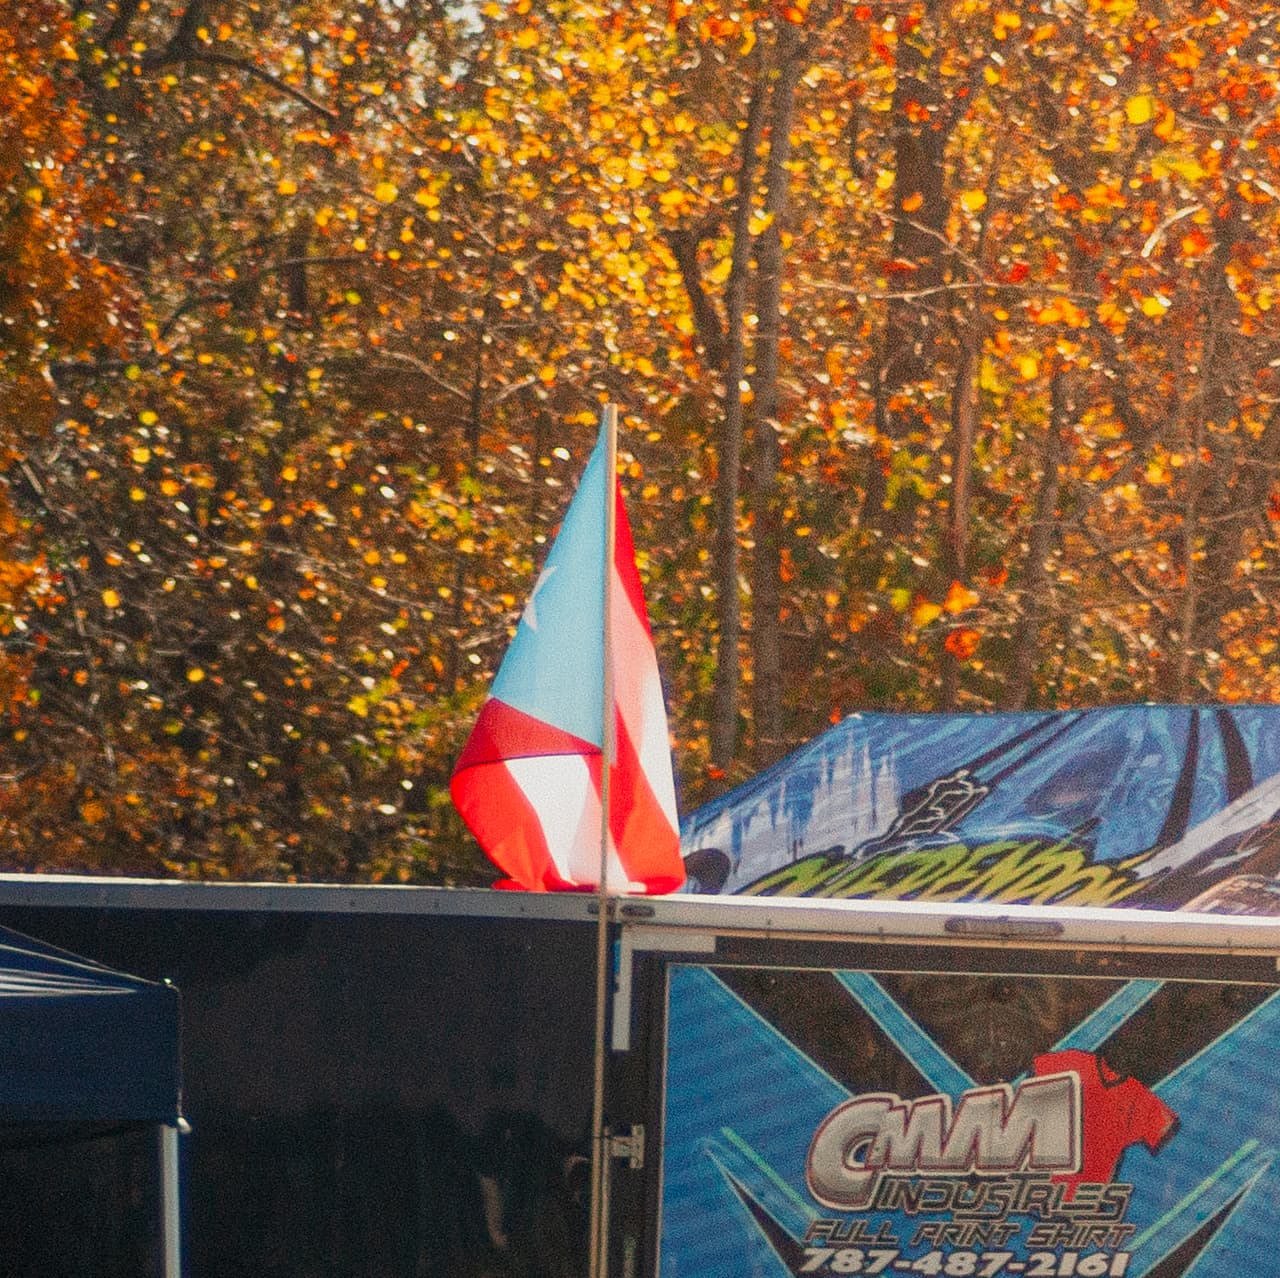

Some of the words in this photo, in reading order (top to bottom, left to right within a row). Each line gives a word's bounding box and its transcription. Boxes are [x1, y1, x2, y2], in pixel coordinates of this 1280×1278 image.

[807, 1071, 1084, 1213] CMM
[804, 1219, 899, 1247] FULL
[910, 1222, 1021, 1249] PRINT
[1025, 1223, 1136, 1250] SHIRT
[798, 1248, 1133, 1278] 787-487-2161
